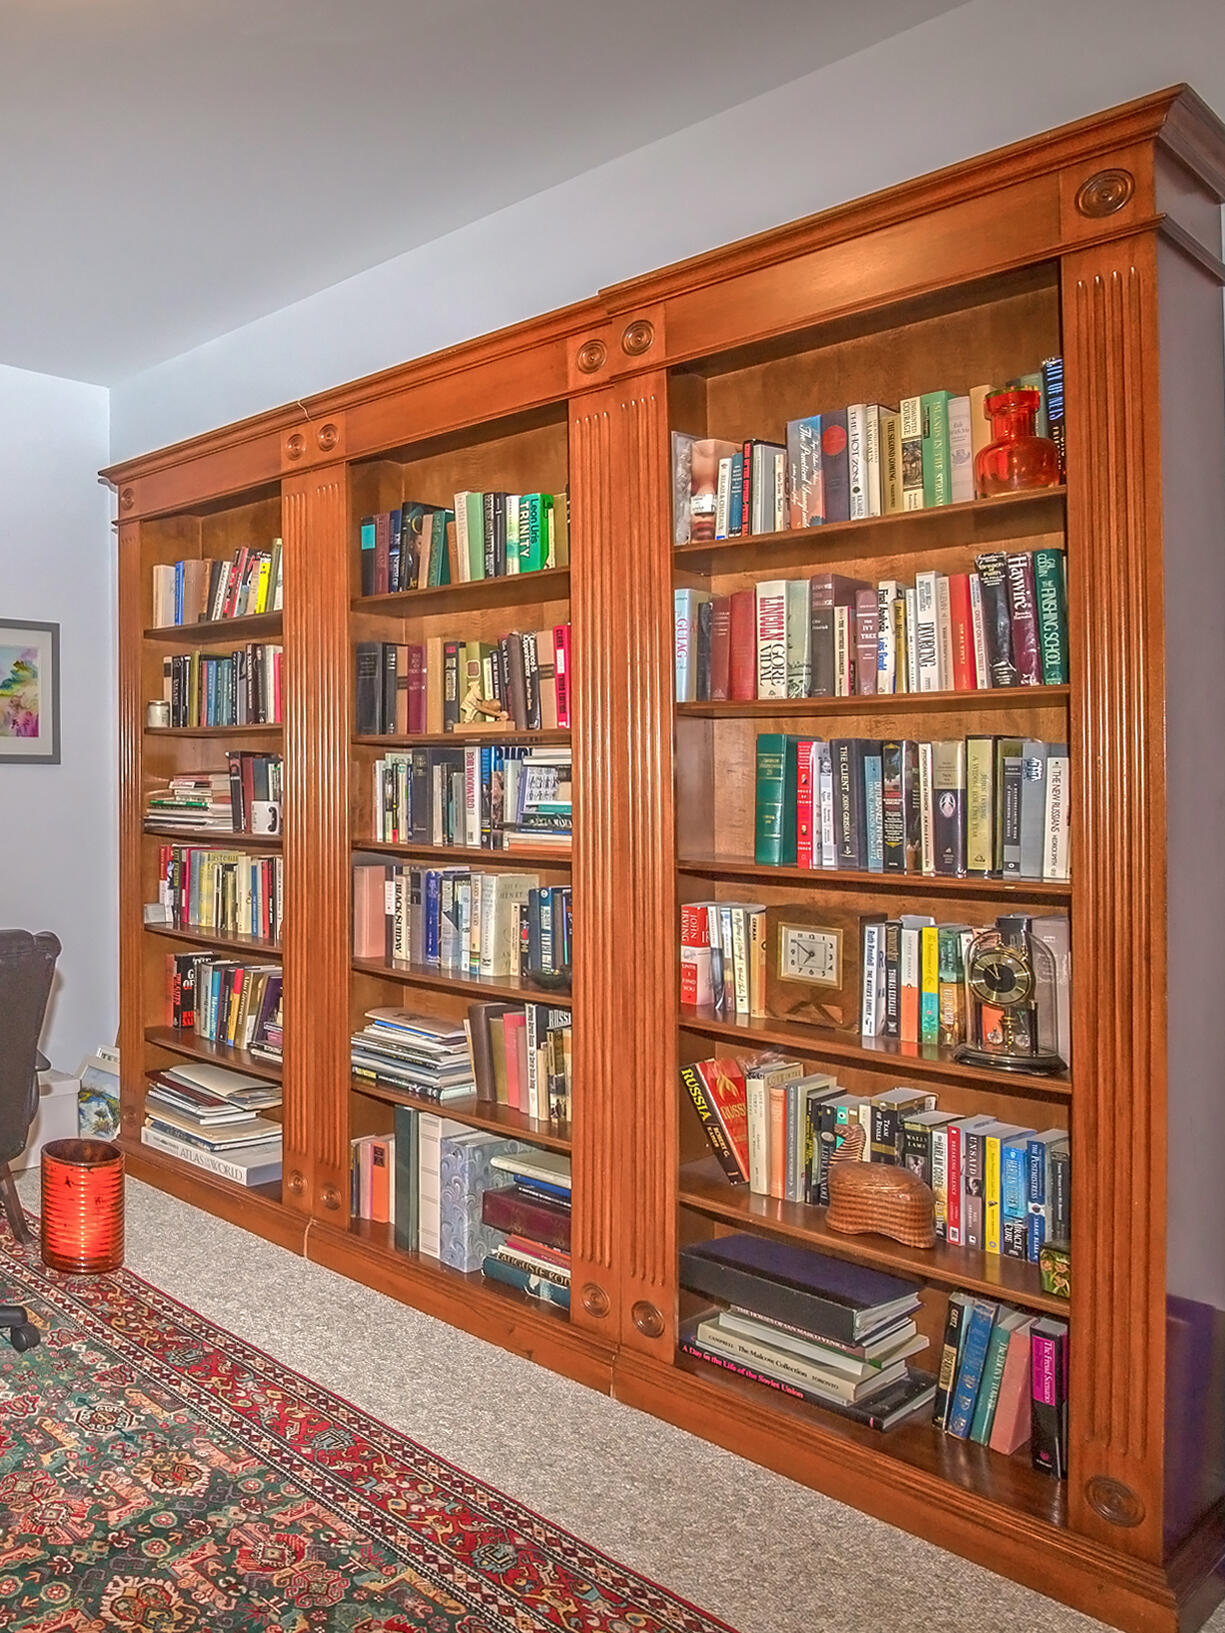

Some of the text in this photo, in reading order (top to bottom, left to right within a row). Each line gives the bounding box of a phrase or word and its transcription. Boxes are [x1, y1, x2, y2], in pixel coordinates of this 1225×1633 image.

[799, 424, 812, 442] The
[903, 401, 911, 435] COURAGE
[933, 401, 943, 438] ISLANDS
[799, 443, 813, 483] Practical
[849, 411, 860, 485] THE HOT ZONE
[887, 420, 897, 481] THE SECOND COMING
[934, 440, 943, 449] IN
[935, 452, 944, 468] THE
[519, 500, 530, 558] TRINITY
[530, 498, 540, 544] Leon Uris
[1007, 556, 1031, 610] Haywire
[759, 595, 785, 642] LINCOLN
[1041, 587, 1060, 632] FINISHING
[522, 634, 531, 677] Oppenheimer
[529, 634, 538, 666] Lawrence
[676, 618, 688, 658] GULAG
[917, 622, 936, 668] DIVORCING
[1044, 632, 1062, 669] SCHOOL
[759, 645, 772, 687] VIDAL
[771, 644, 786, 687] GORE
[466, 751, 475, 809] BOB WOODWARD
[839, 746, 851, 842] THE CLIENT JOHN GRISHAM
[1051, 771, 1061, 833] THE NEW RUSSIANS
[681, 910, 689, 943] IRVING
[689, 914, 697, 940] JOHN
[866, 930, 875, 967] Ruth Rendell
[681, 1068, 712, 1121] RUSSIA
[720, 1103, 746, 1119] RUSSI
[180, 1146, 243, 1181] ATLAS WORLD
[933, 1140, 944, 1188] HARLAN COBEN
[968, 1136, 977, 1175] UNSAID
[1031, 1144, 1041, 1199] THE POSTMISTRESS
[1006, 1159, 1019, 1208] HARLAN COBEN
[1003, 1222, 1014, 1243] CURE
[1012, 1219, 1025, 1251] MIRACLE
[499, 1253, 571, 1287] AUGUSTE ROD
[736, 1306, 749, 1316] THE
[749, 1311, 774, 1324] HORSES
[681, 1344, 804, 1398] A Day in the Life of the Soviet Union
[708, 1334, 735, 1349] CAMPBELL
[738, 1345, 749, 1355] The
[775, 1359, 808, 1378] Collection
[811, 1375, 839, 1390] TORONTO
[987, 1342, 1008, 1411] The EBONY TOWER
[1043, 1341, 1053, 1404] The Freud Scenario
